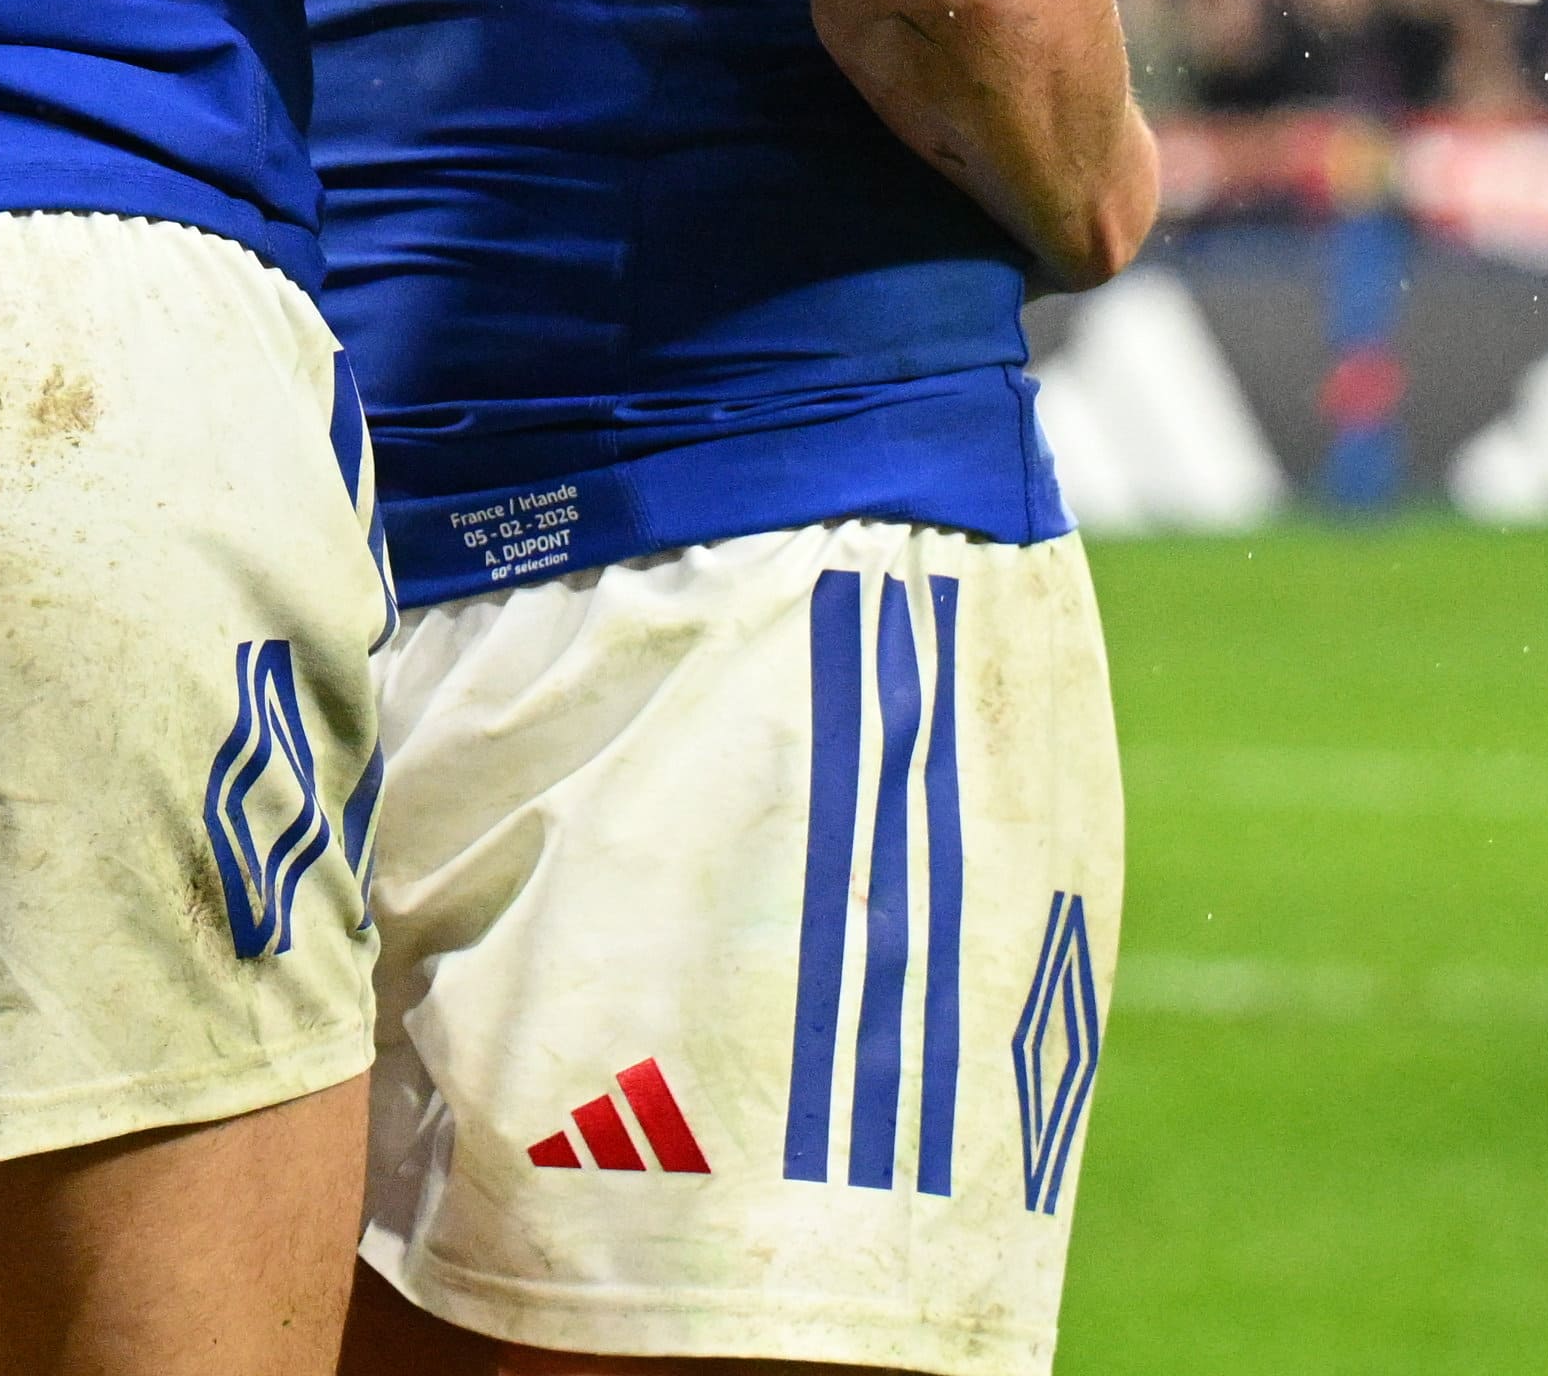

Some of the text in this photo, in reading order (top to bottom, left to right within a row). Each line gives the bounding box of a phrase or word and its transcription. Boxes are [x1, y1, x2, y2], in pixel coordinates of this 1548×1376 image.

[450, 504, 506, 529] France
[519, 484, 578, 512] Irlande
[463, 527, 488, 549] 05
[499, 519, 524, 539] 02
[535, 505, 579, 531] 2026
[484, 529, 571, 568] A. DUPONT
